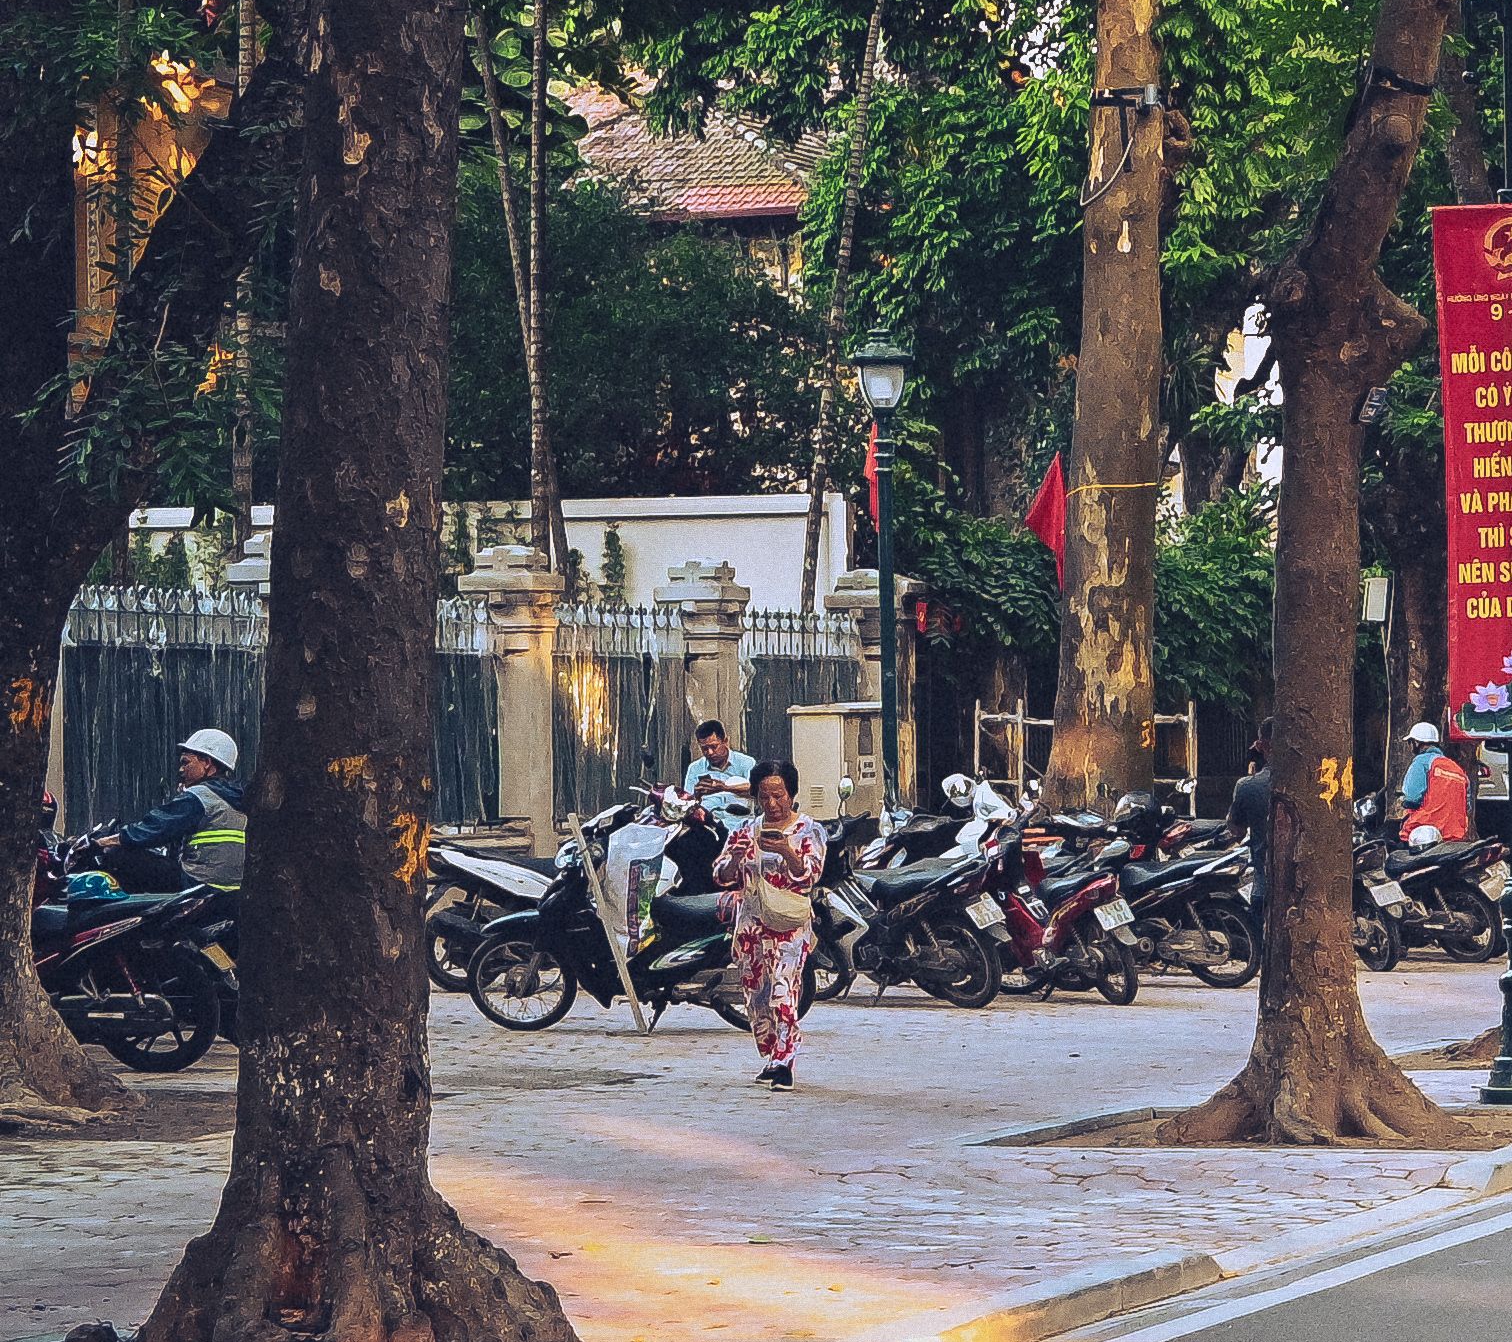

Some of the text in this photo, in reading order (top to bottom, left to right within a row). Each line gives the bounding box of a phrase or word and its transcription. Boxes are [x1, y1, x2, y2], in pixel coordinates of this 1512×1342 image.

[1450, 344, 1486, 374] MỖI
[1475, 382, 1499, 408] CÓ
[1472, 449, 1512, 479] HIẾN
[1459, 488, 1484, 514] VÀ
[1477, 522, 1505, 549] THÌ
[1458, 558, 1495, 584] NÊN
[1466, 590, 1503, 619] CỦA
